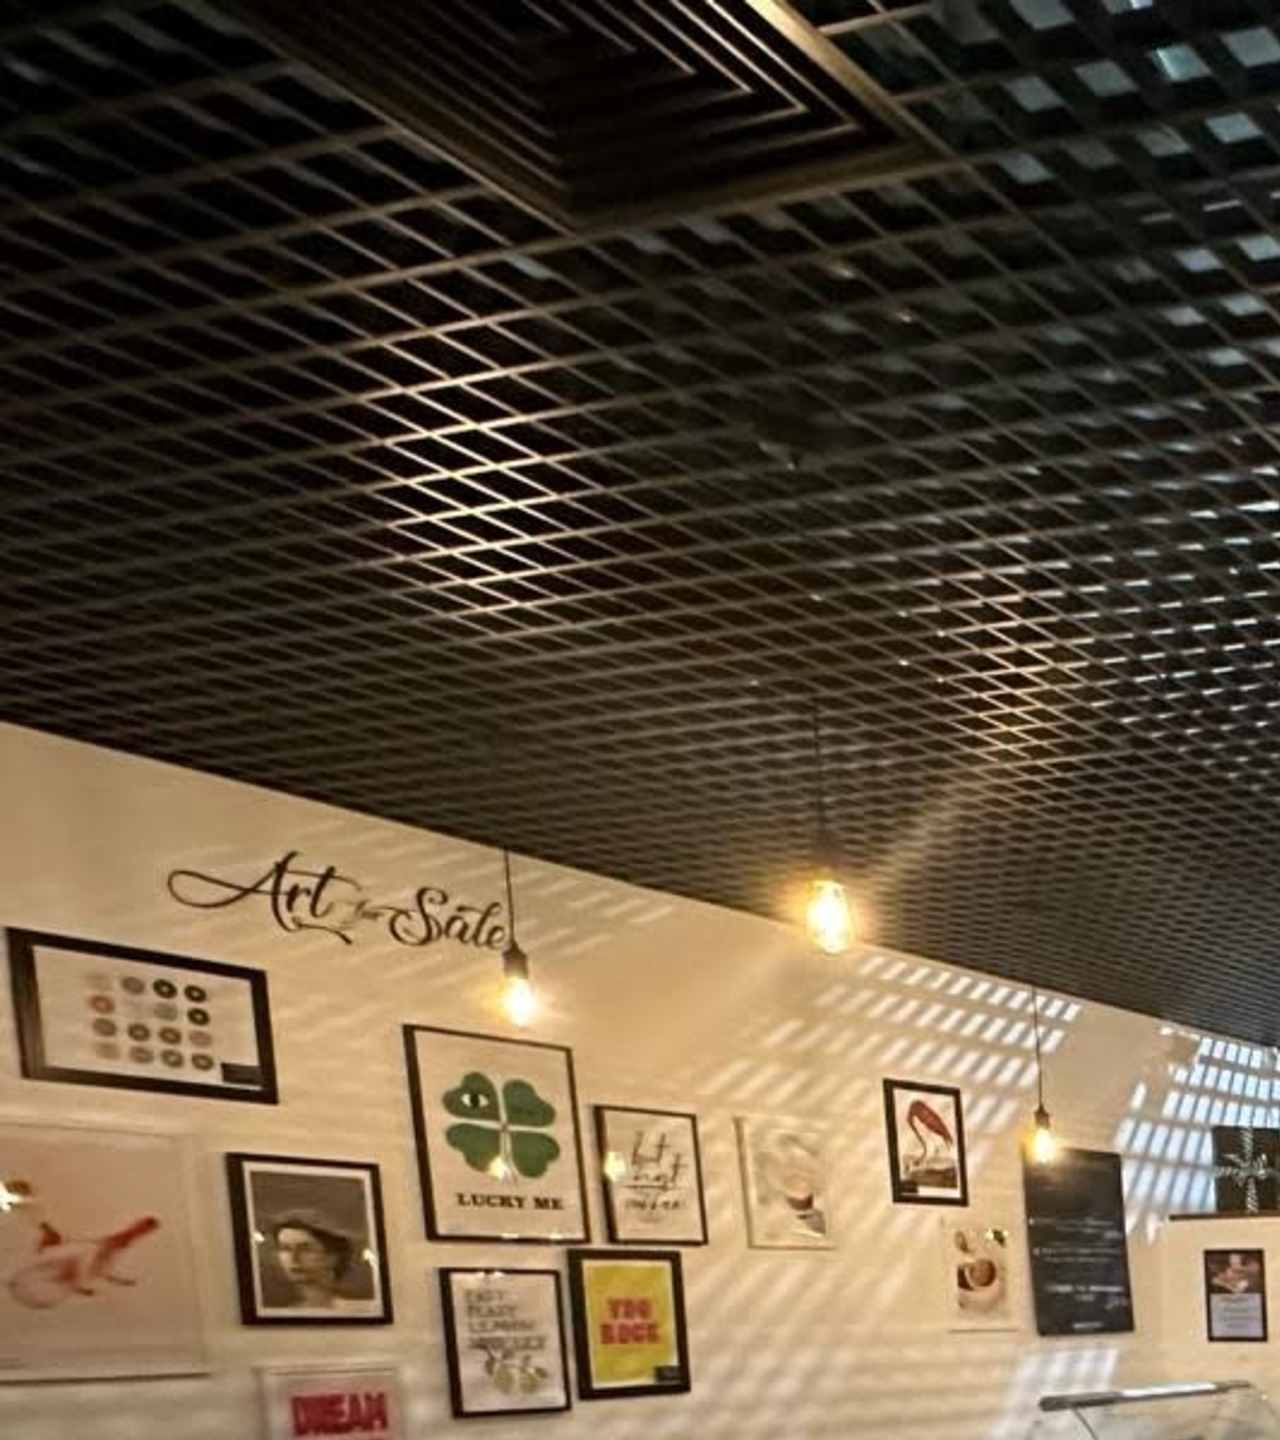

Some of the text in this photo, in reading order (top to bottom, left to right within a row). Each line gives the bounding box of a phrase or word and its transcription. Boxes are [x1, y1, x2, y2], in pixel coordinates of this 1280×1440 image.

[167, 851, 362, 945] Art
[388, 886, 508, 949] Sale
[456, 1191, 564, 1210] LUCKY ME
[607, 1297, 652, 1320] YOU
[600, 1322, 661, 1345] ROCK
[292, 1393, 388, 1437] DREAM
